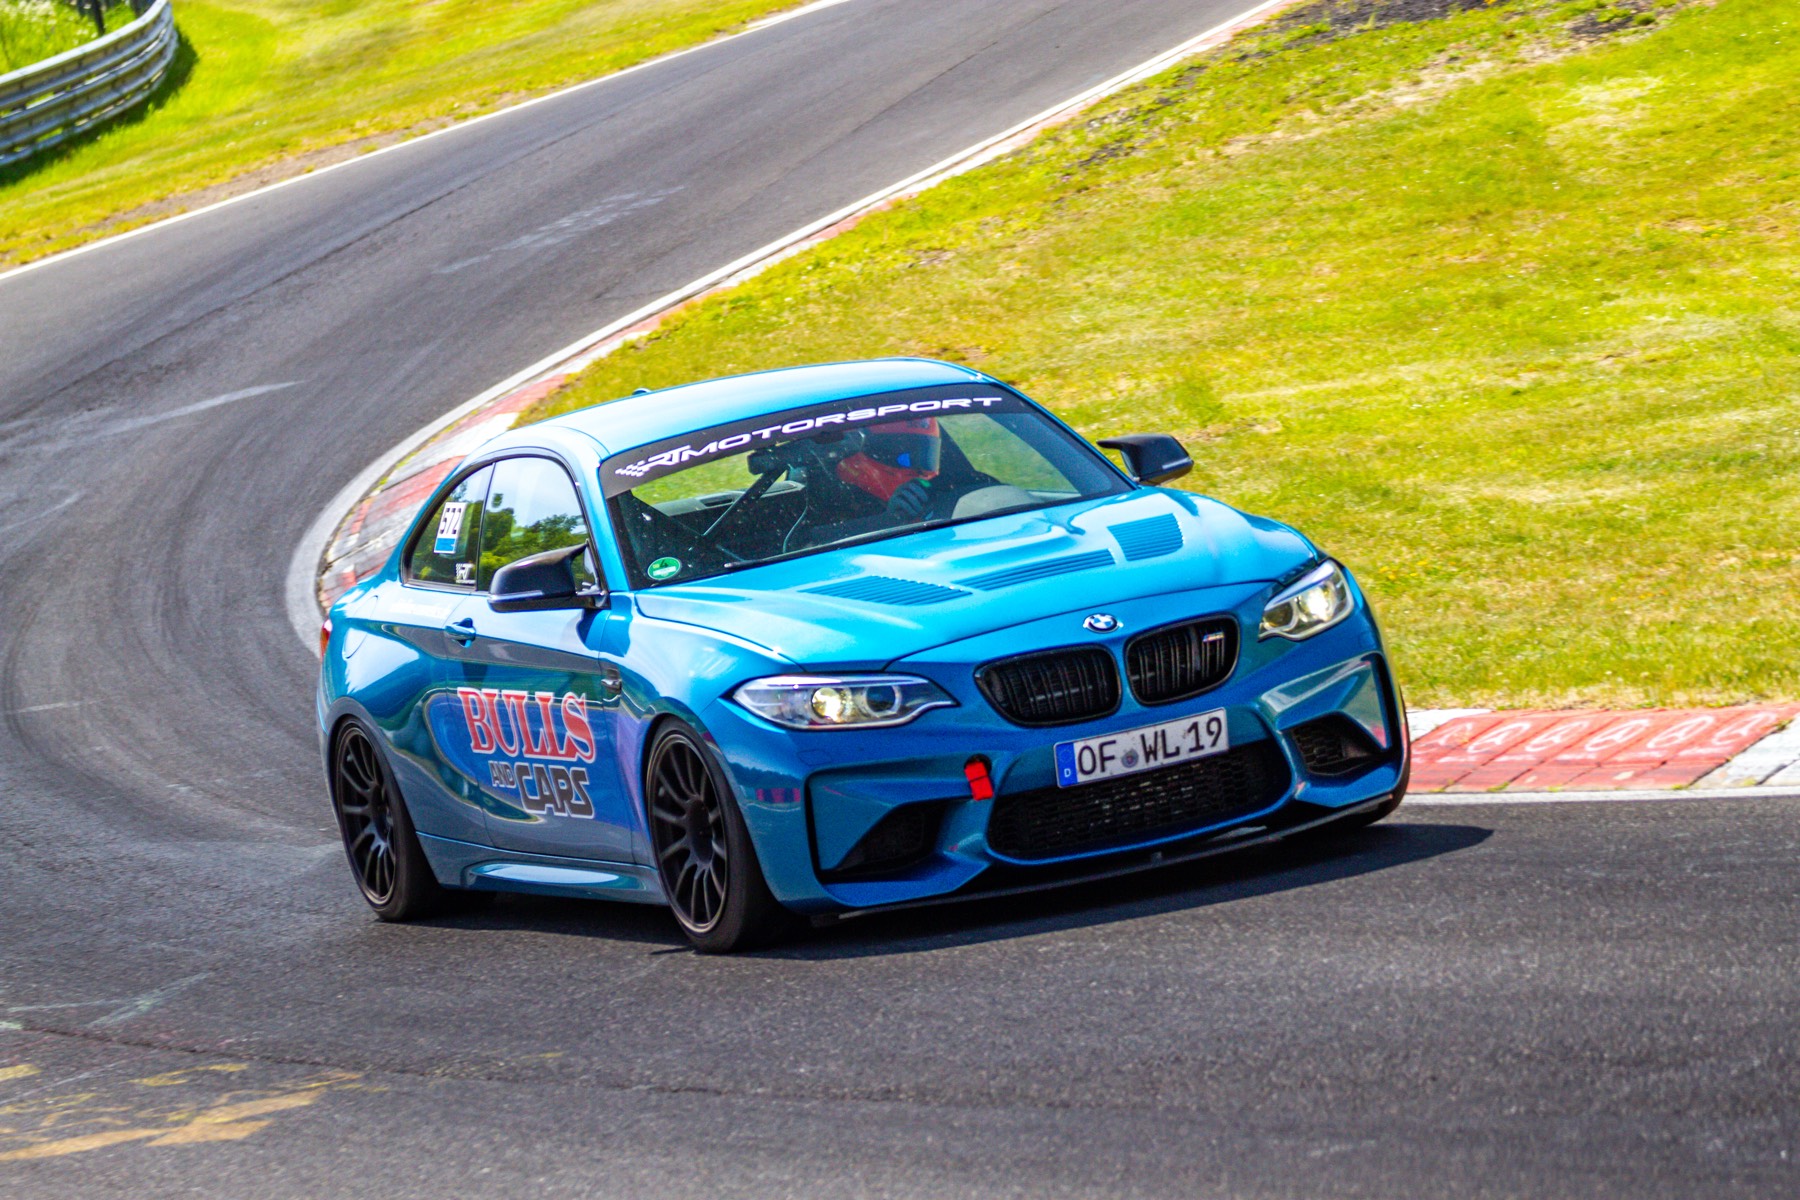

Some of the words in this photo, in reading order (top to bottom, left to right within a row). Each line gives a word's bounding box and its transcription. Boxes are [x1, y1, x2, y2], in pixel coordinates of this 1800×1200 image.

[439, 507, 462, 535] 572
[457, 687, 596, 764] BULLS
[1063, 767, 1072, 778] D
[1077, 739, 1117, 776] OF
[1140, 728, 1181, 764] WL
[1186, 716, 1223, 753] 19
[488, 760, 517, 789] AND
[514, 762, 595, 819] CARS
